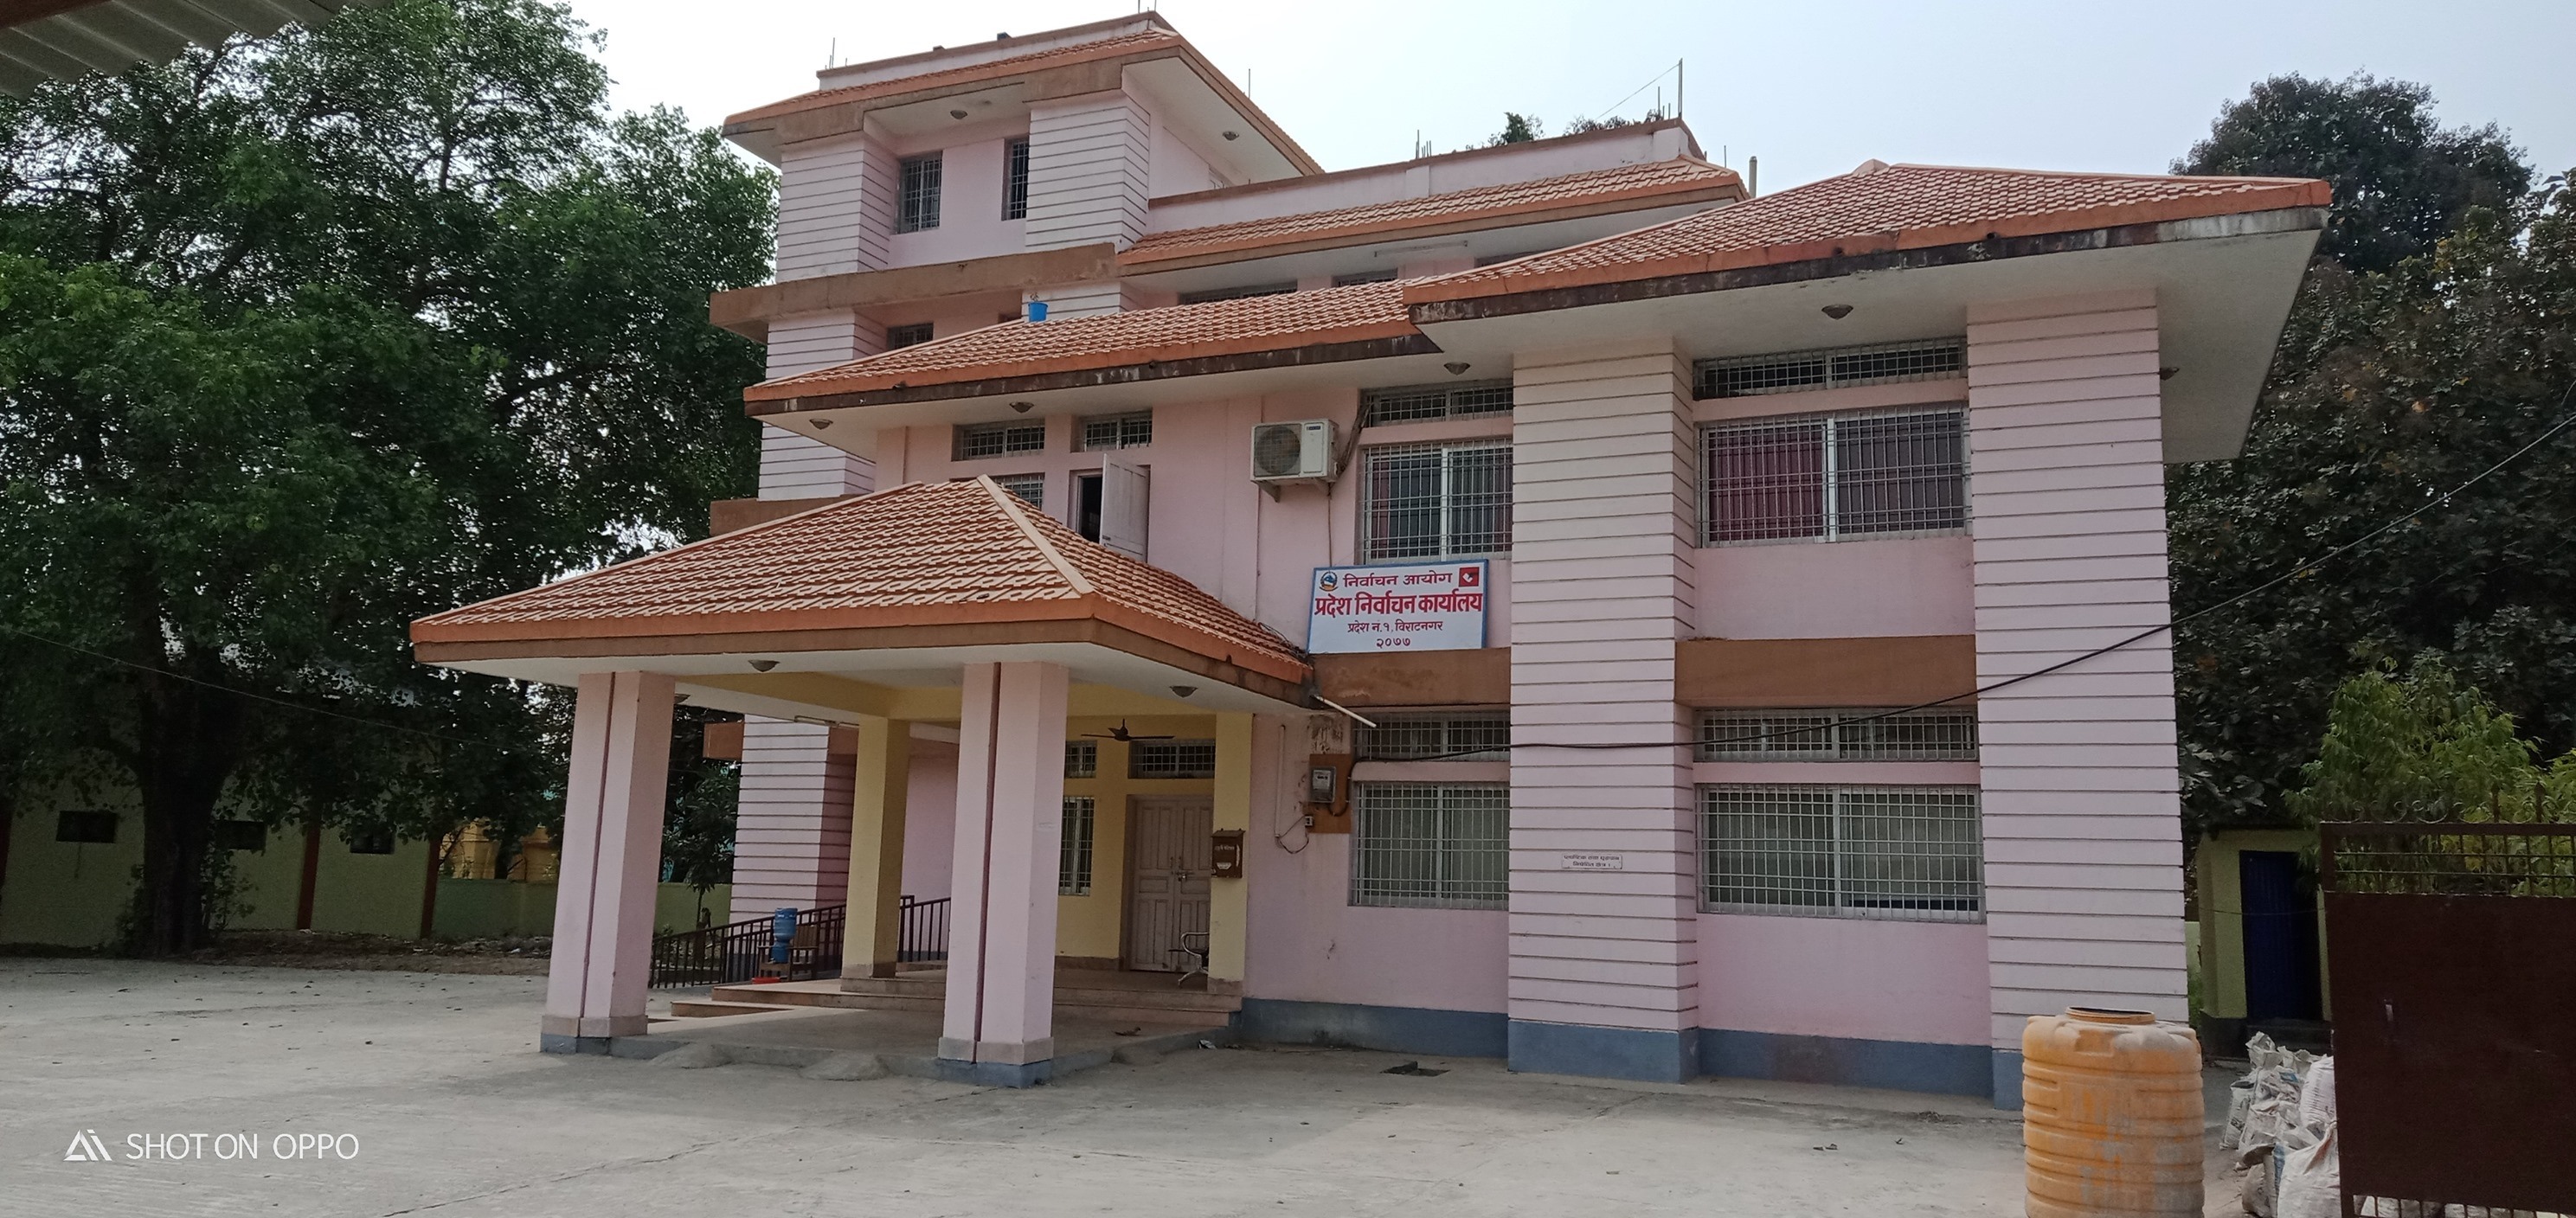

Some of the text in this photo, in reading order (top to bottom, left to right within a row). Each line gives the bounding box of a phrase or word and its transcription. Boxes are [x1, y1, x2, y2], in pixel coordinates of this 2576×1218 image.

[1343, 570, 1453, 587] निर्वाचन आयोग
[1314, 588, 1483, 618] प्रदेश निर्वाचन कार्यालय
[1347, 620, 1370, 634] प्रदेश
[1395, 619, 1443, 632] विराटनगर
[1376, 638, 1411, 648] २०७७
